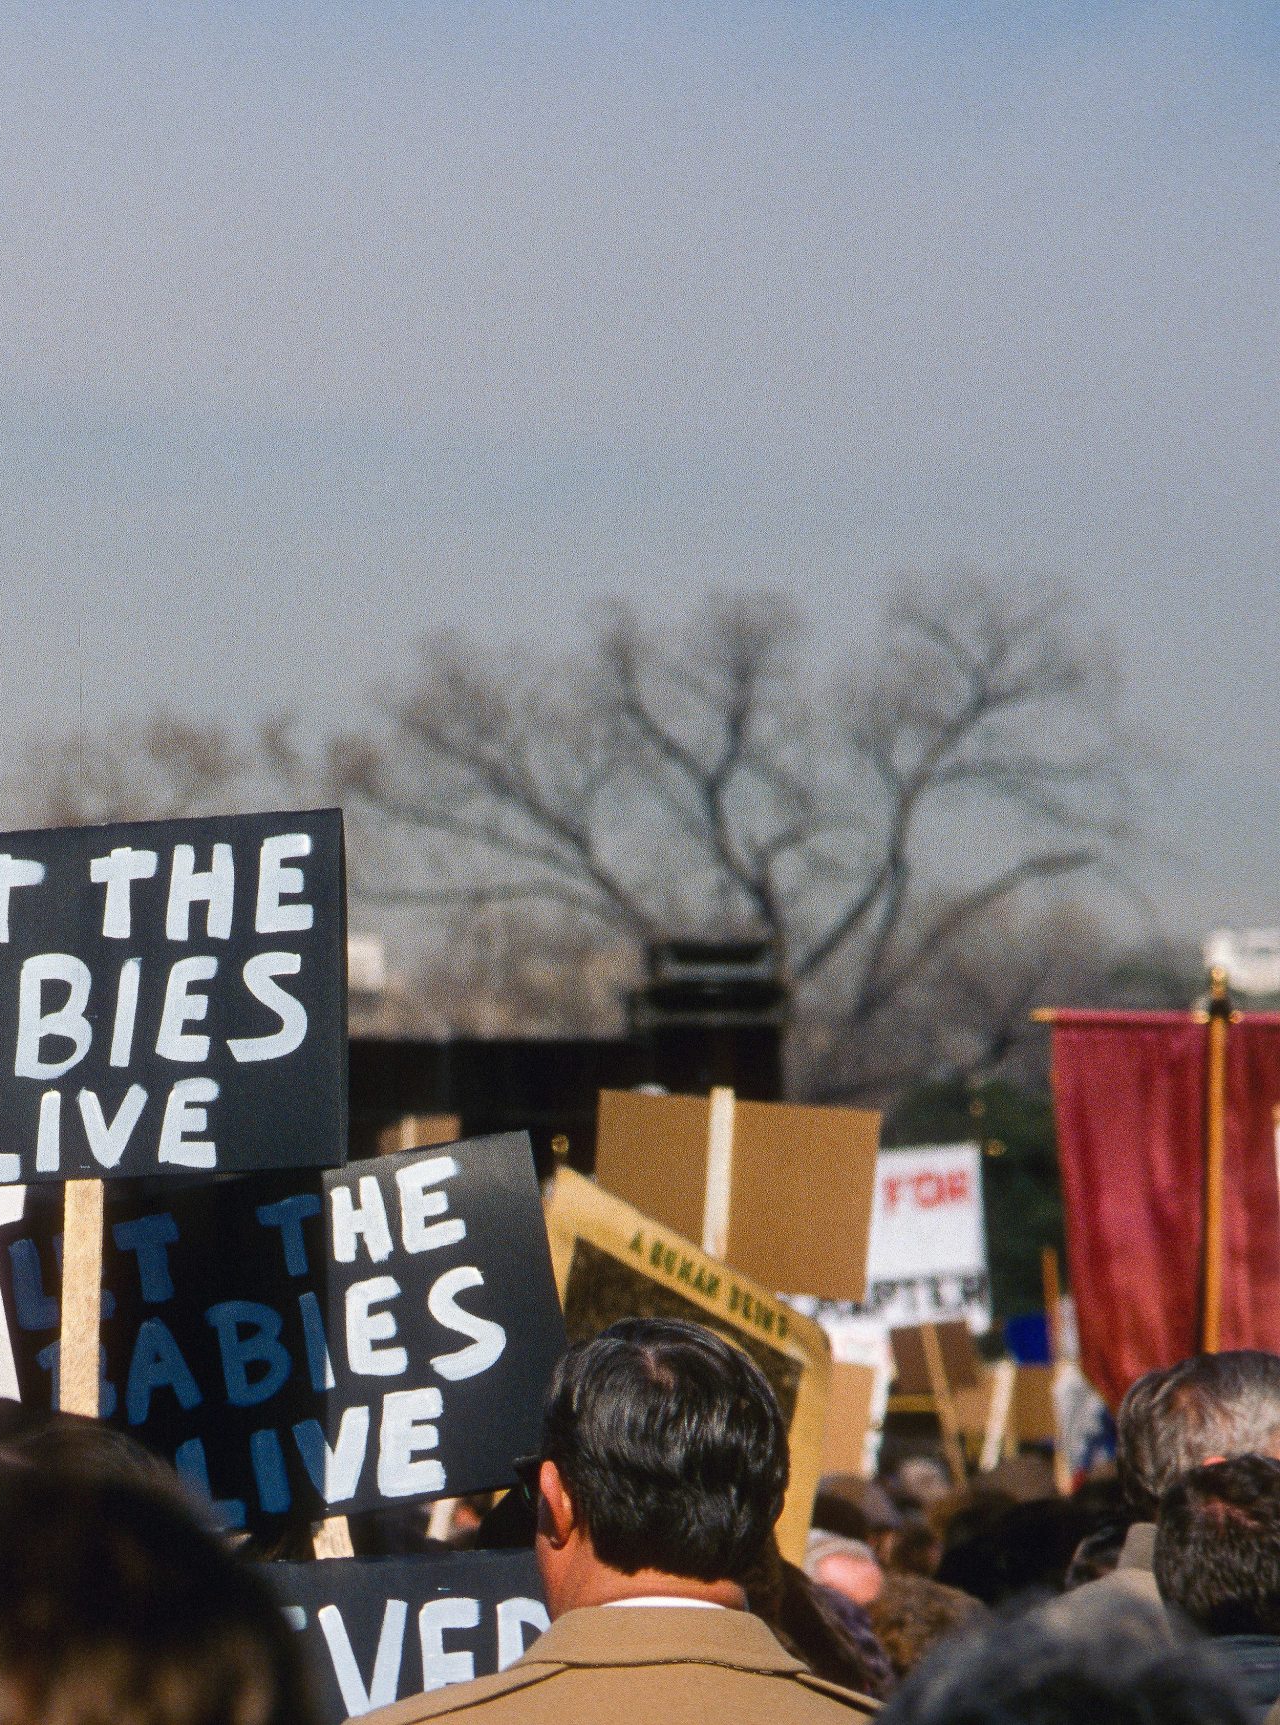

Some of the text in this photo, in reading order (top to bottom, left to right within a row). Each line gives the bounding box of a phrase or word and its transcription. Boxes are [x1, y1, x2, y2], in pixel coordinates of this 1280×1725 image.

[90, 833, 314, 941] THE
[7, 1156, 467, 1330] LT THE
[175, 1387, 446, 1530] LIVE
